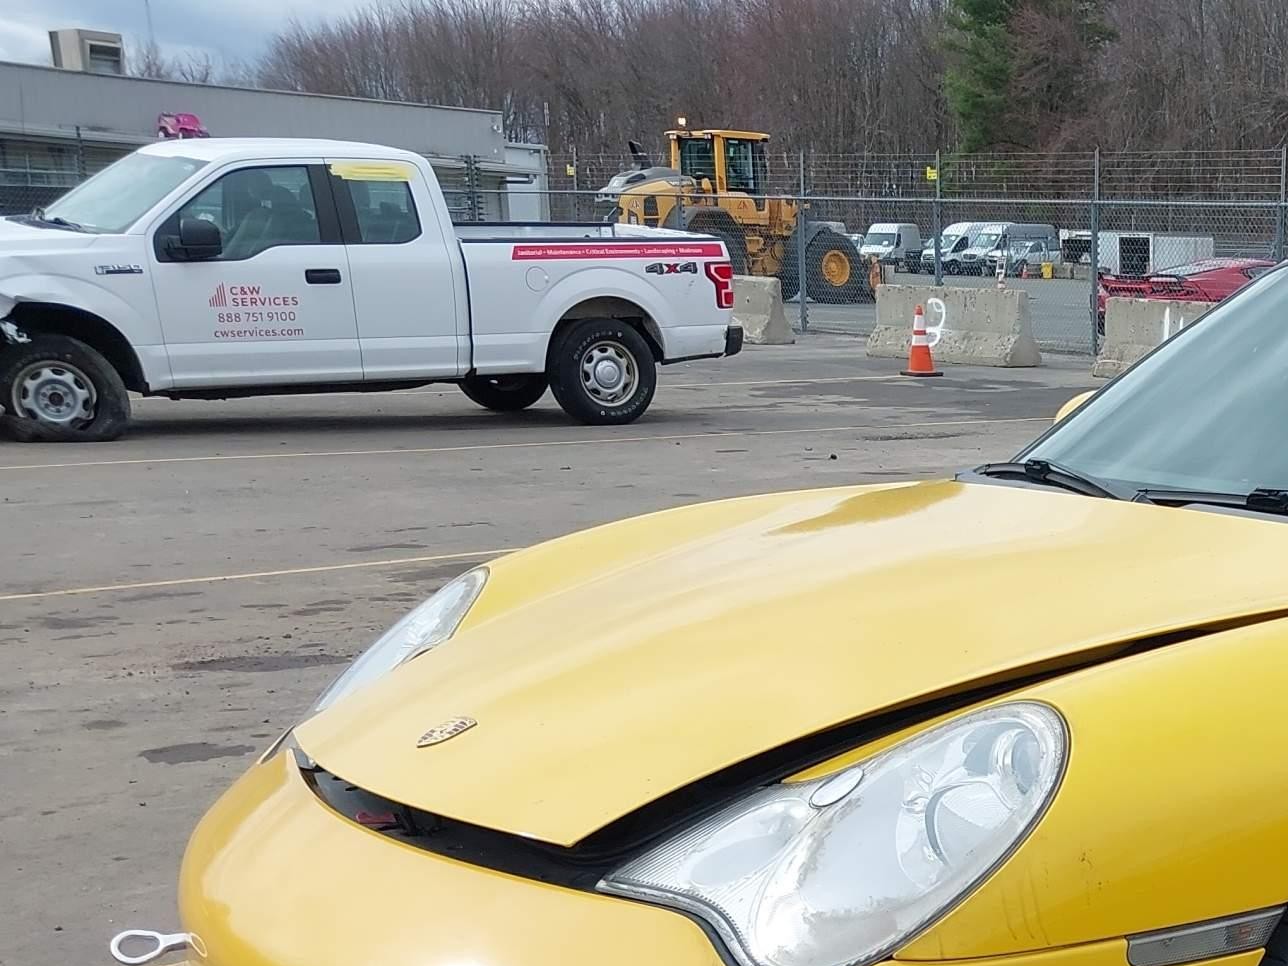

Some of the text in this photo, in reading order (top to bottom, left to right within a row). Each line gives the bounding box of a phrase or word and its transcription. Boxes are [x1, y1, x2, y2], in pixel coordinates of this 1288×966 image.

[229, 286, 261, 296] C&W
[231, 297, 299, 307] SERVICES
[217, 311, 297, 323] 888 751 9100
[213, 327, 305, 338] cwservices.com
